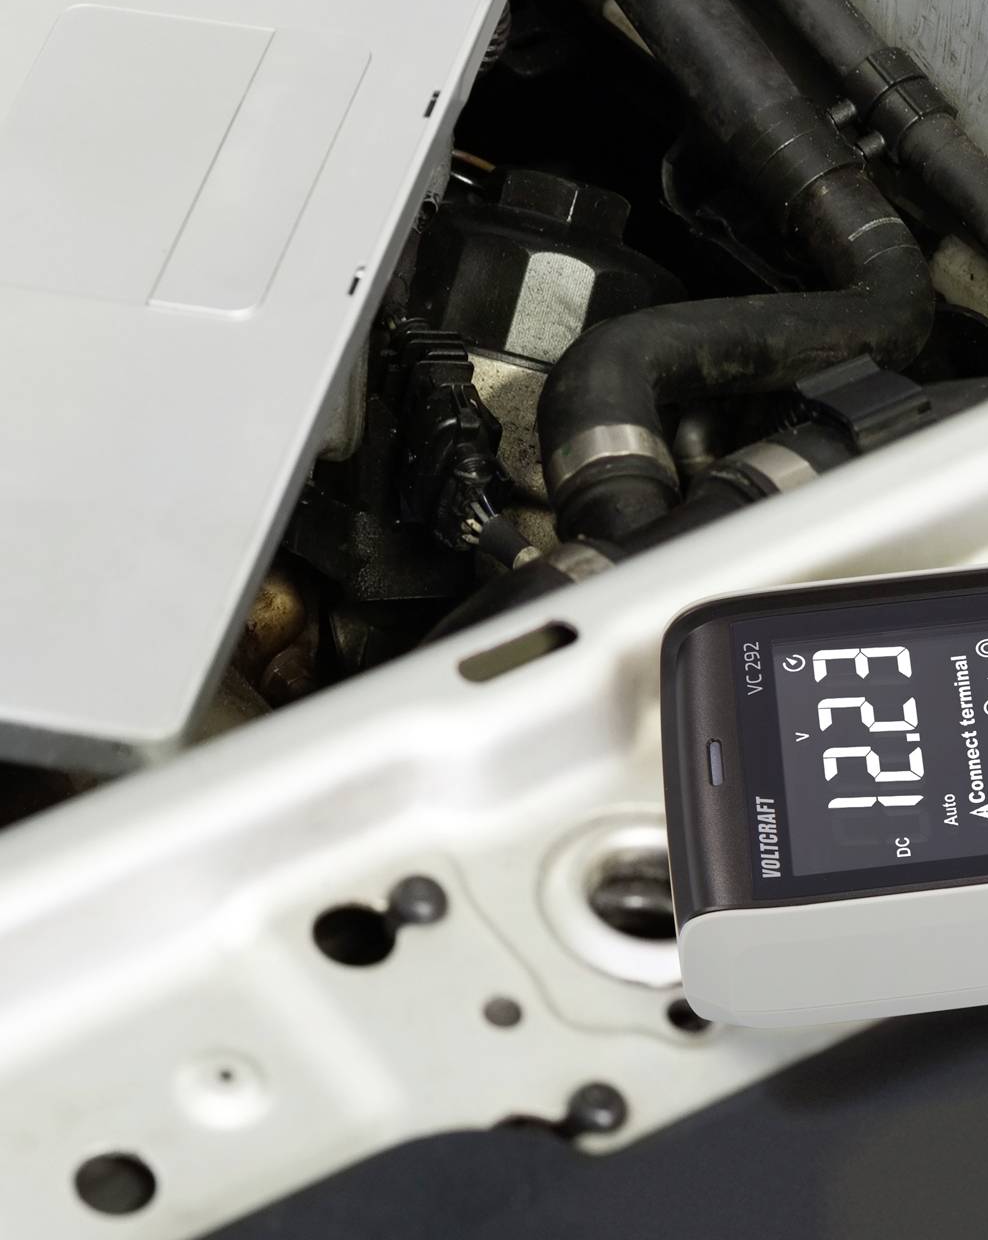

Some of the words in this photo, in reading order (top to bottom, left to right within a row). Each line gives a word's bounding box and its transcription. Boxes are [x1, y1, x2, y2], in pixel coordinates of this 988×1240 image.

[744, 641, 761, 669] 292
[746, 674, 763, 695] VC
[950, 655, 978, 726] terminal
[813, 646, 925, 809] 12.23
[960, 731, 986, 804] Connect
[941, 793, 958, 826] Auto
[755, 796, 781, 878] VOLTCRAFT
[894, 837, 911, 857] DC
